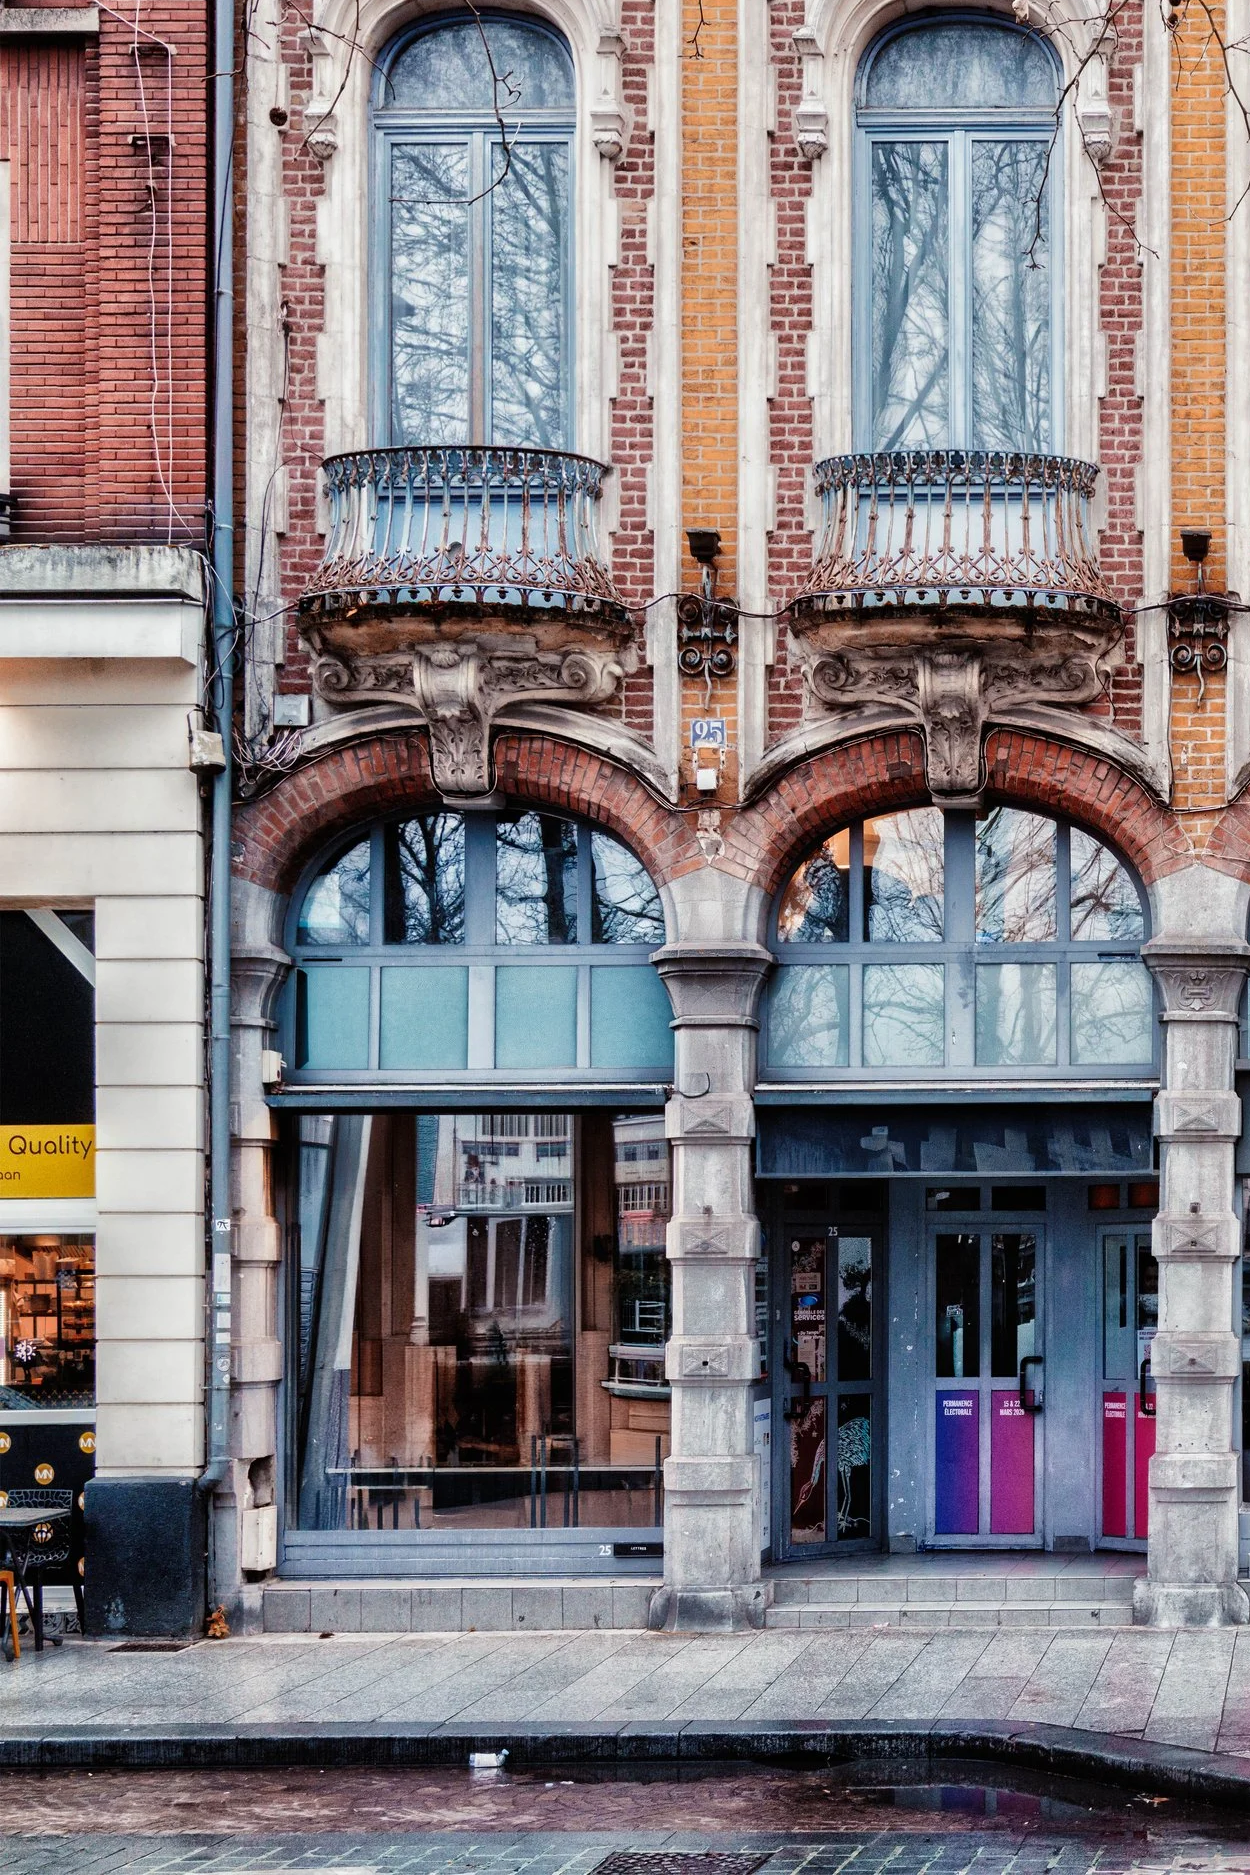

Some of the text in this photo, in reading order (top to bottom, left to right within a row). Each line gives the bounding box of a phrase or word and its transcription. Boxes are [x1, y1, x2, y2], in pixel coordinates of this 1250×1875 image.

[9, 1135, 92, 1160] Quality
[828, 1226, 838, 1236] 25
[36, 1469, 53, 1479] MN
[599, 1545, 611, 1555] 25
